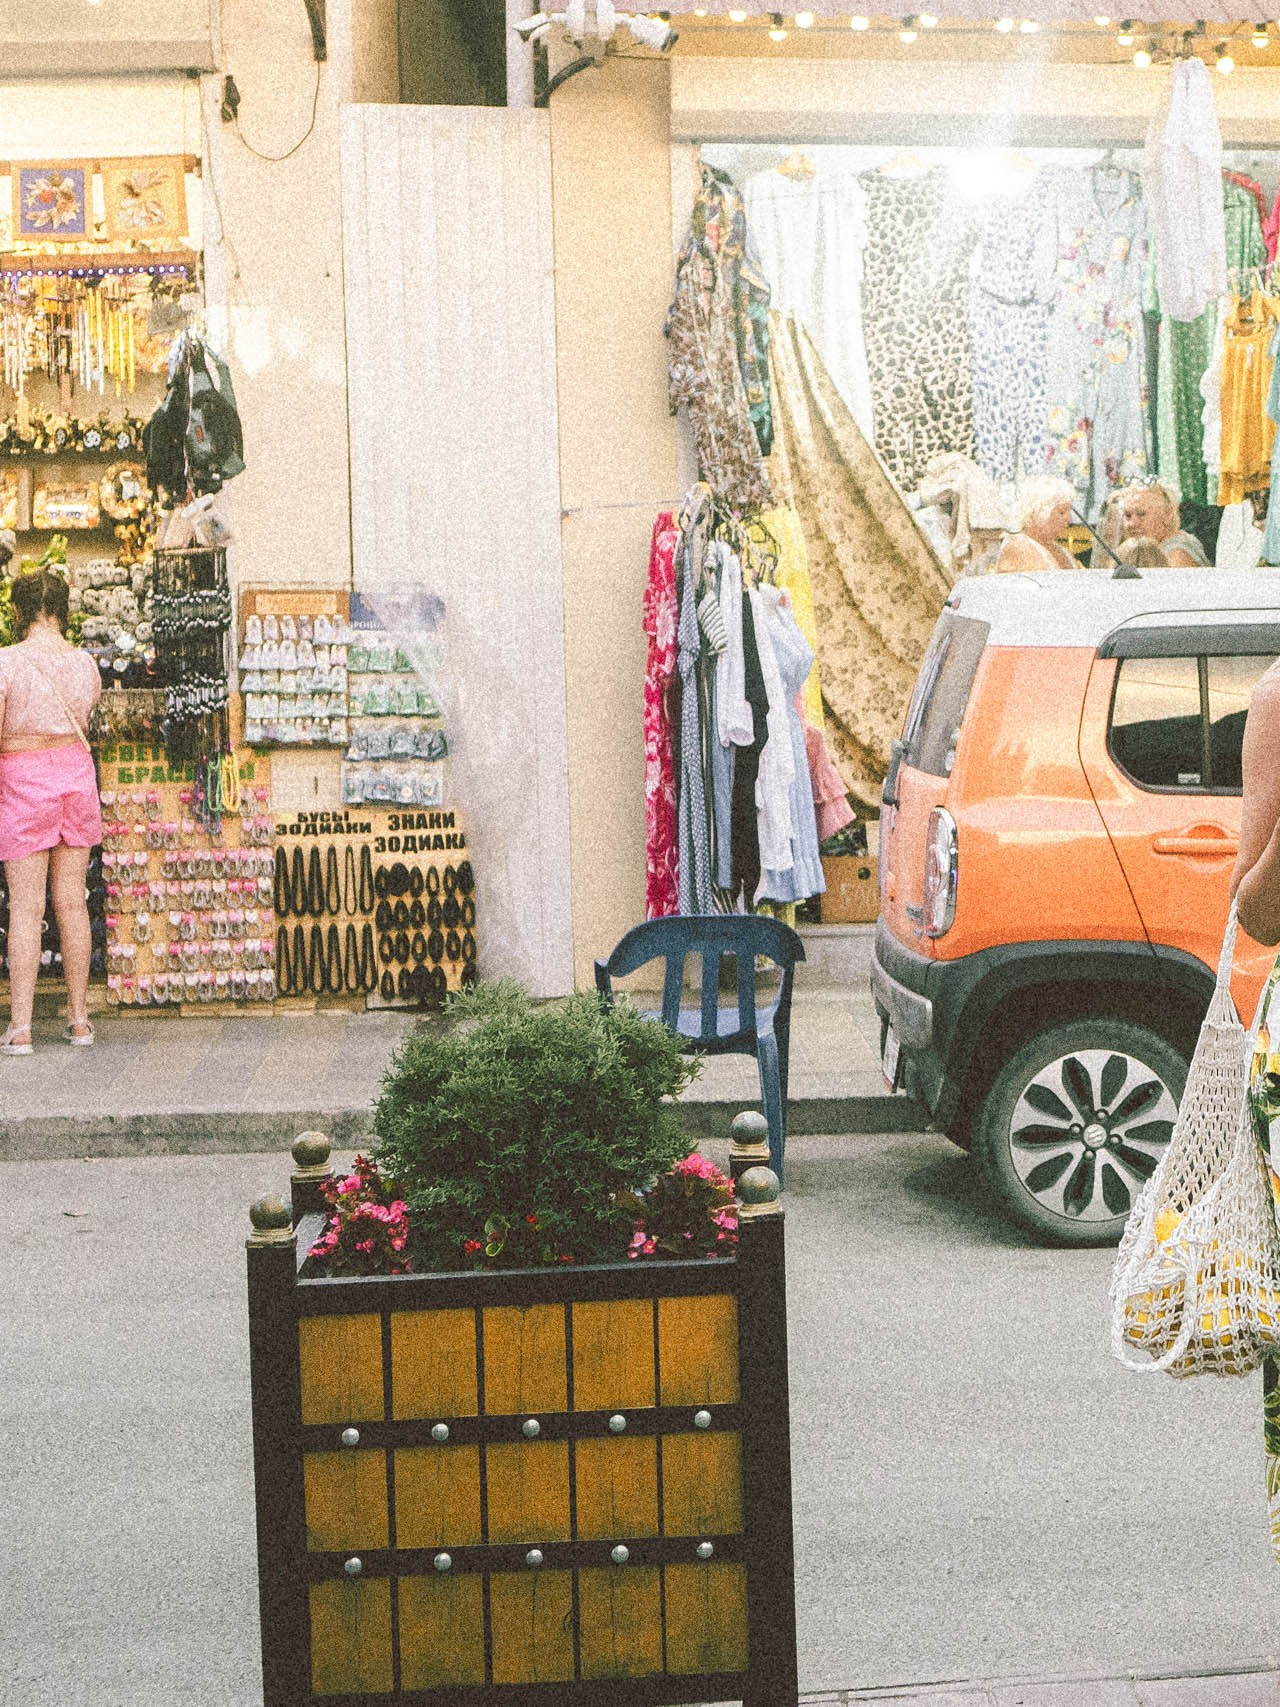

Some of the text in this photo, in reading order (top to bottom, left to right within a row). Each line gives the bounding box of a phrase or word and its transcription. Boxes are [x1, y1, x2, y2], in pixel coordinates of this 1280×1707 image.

[118, 763, 254, 783] БРАСЛЫ
[297, 810, 350, 823] БУСЫ
[388, 811, 456, 831] ЗНАКИ
[275, 821, 372, 837] ЗОДИАКИ
